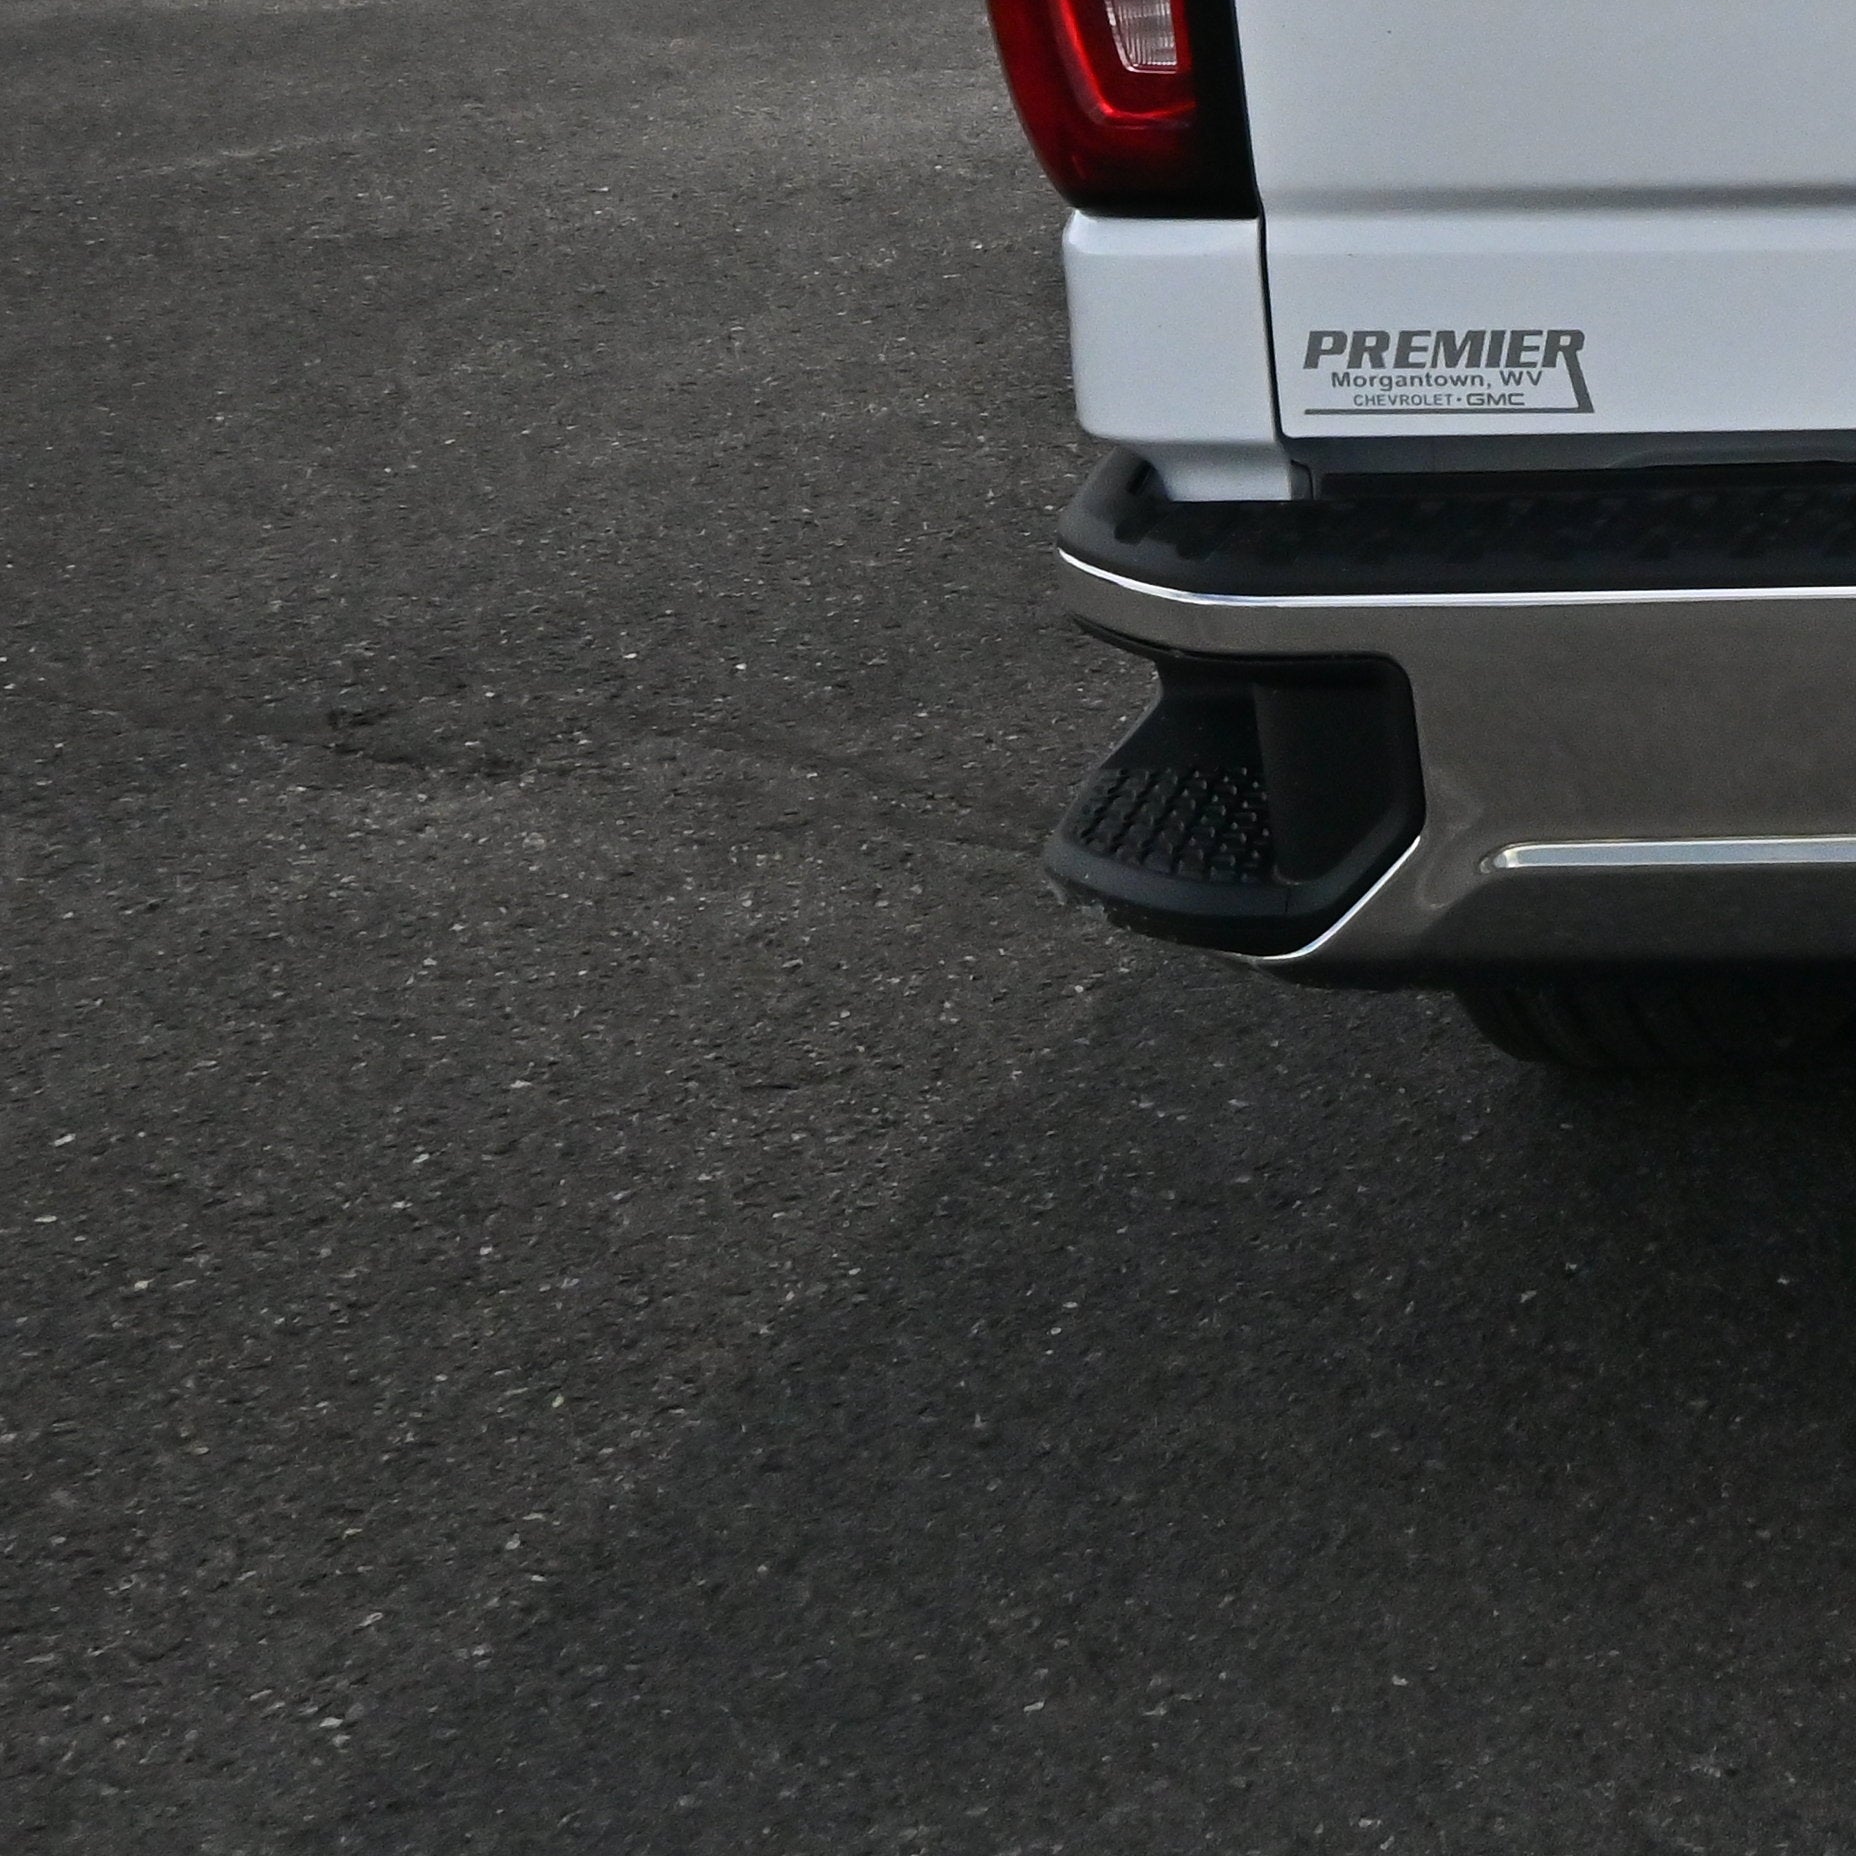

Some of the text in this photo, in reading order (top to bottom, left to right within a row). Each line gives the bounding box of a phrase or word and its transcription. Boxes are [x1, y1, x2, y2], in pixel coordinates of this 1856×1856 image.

[1303, 329, 1586, 372] PREMIER
[1331, 370, 1543, 392] Morgantown, WV
[1466, 392, 1525, 406] GMC
